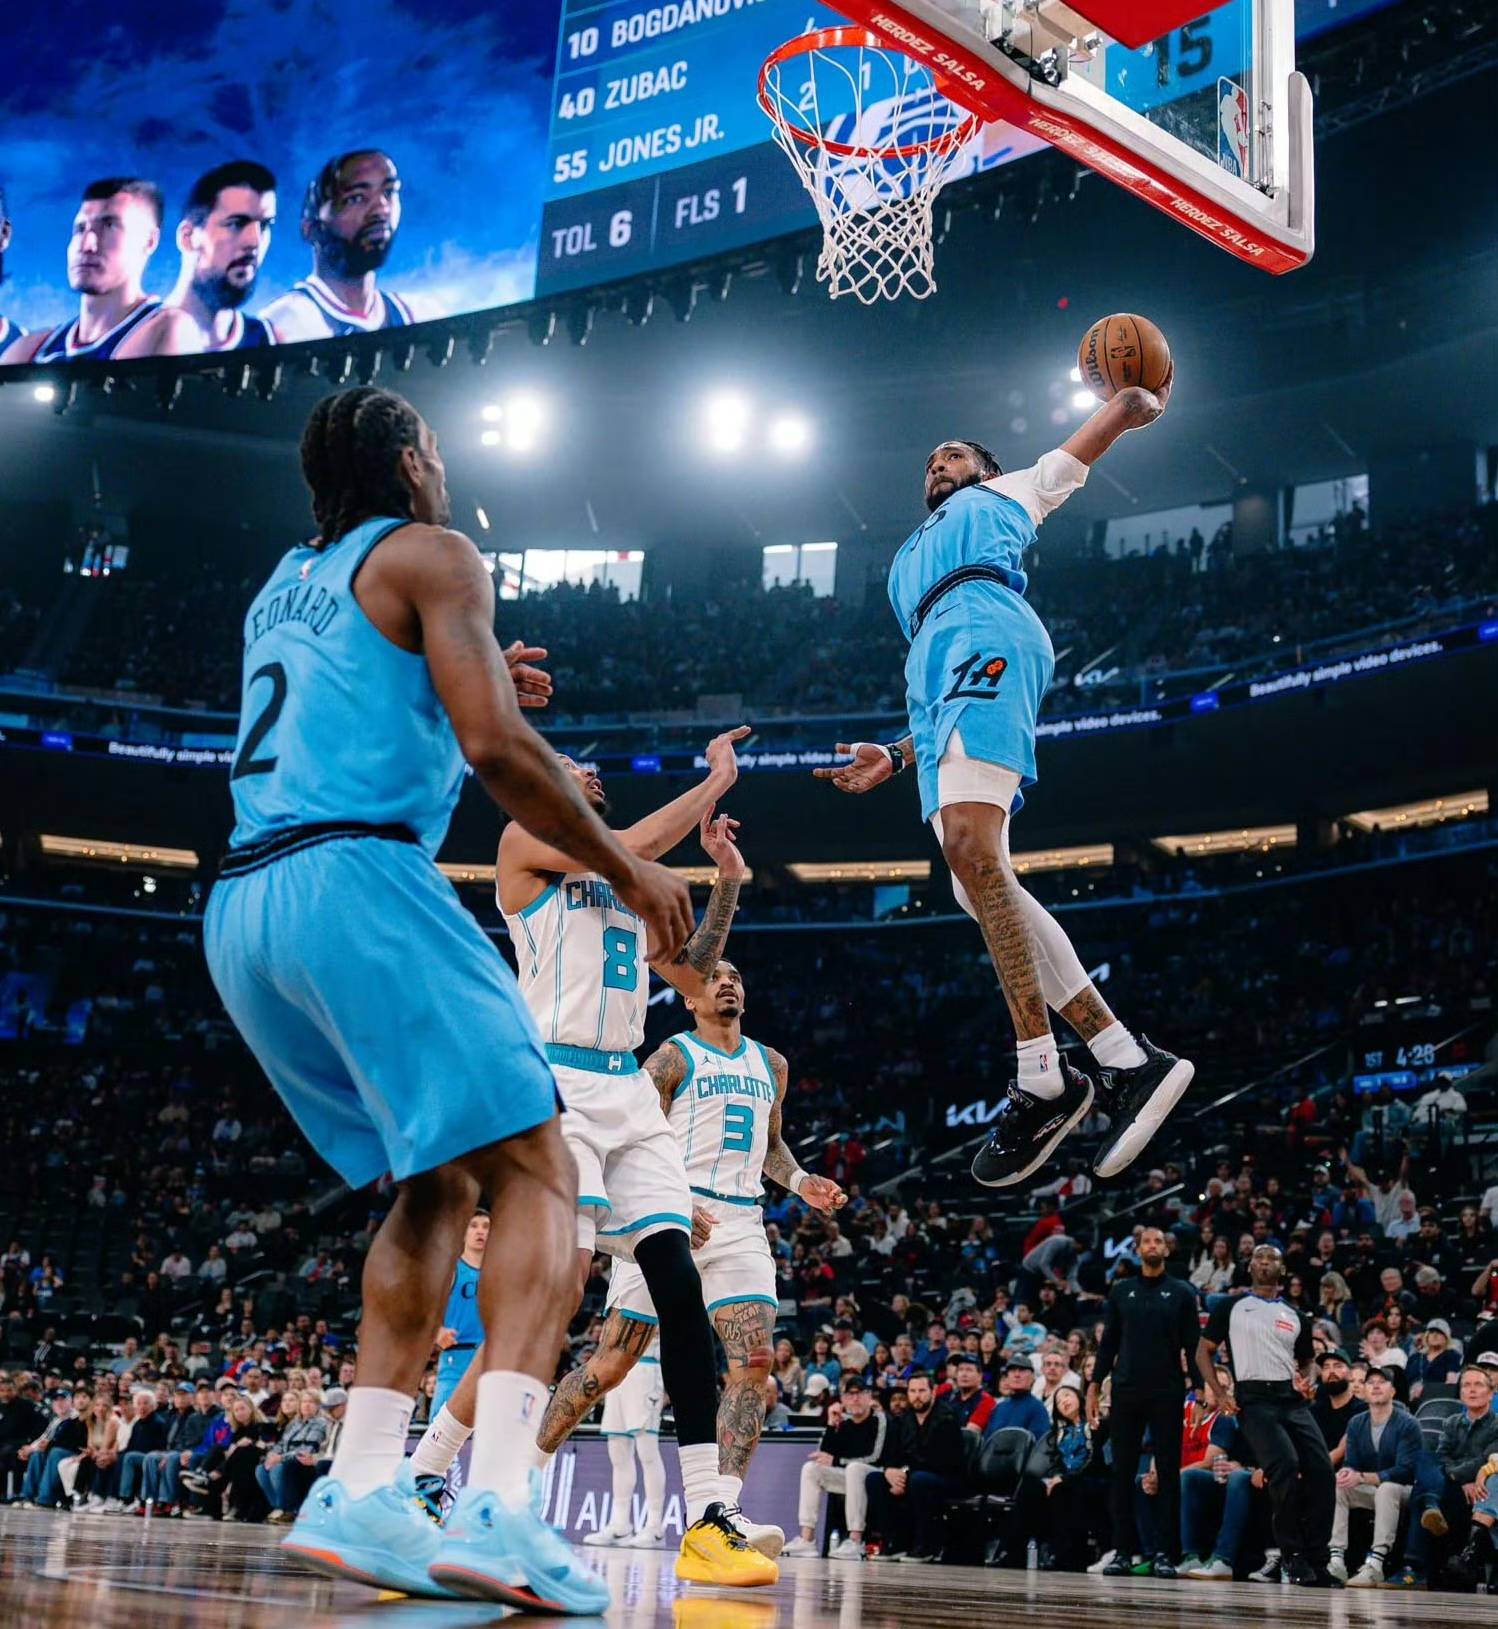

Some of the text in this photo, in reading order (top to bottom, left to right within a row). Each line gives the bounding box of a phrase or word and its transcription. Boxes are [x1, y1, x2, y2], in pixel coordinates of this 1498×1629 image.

[567, 26, 599, 60] 10
[871, 14, 986, 92] HERDEZ SALSA
[558, 60, 688, 120] 40 ZUBAC
[553, 149, 588, 183] 55
[598, 123, 682, 172] JONES
[684, 113, 726, 148] JR.
[674, 176, 748, 229] FLS 1
[1169, 196, 1265, 257] HERDEZ SALSA
[551, 210, 633, 259] TOL 6
[246, 585, 339, 655] EONARD
[1312, 661, 1353, 681] simple
[1353, 653, 1388, 671] video
[229, 661, 287, 781] 2
[1074, 716, 1109, 731] video
[176, 749, 217, 765] simple
[798, 750, 832, 764] video
[603, 926, 637, 992] 8
[723, 1104, 754, 1152] 3
